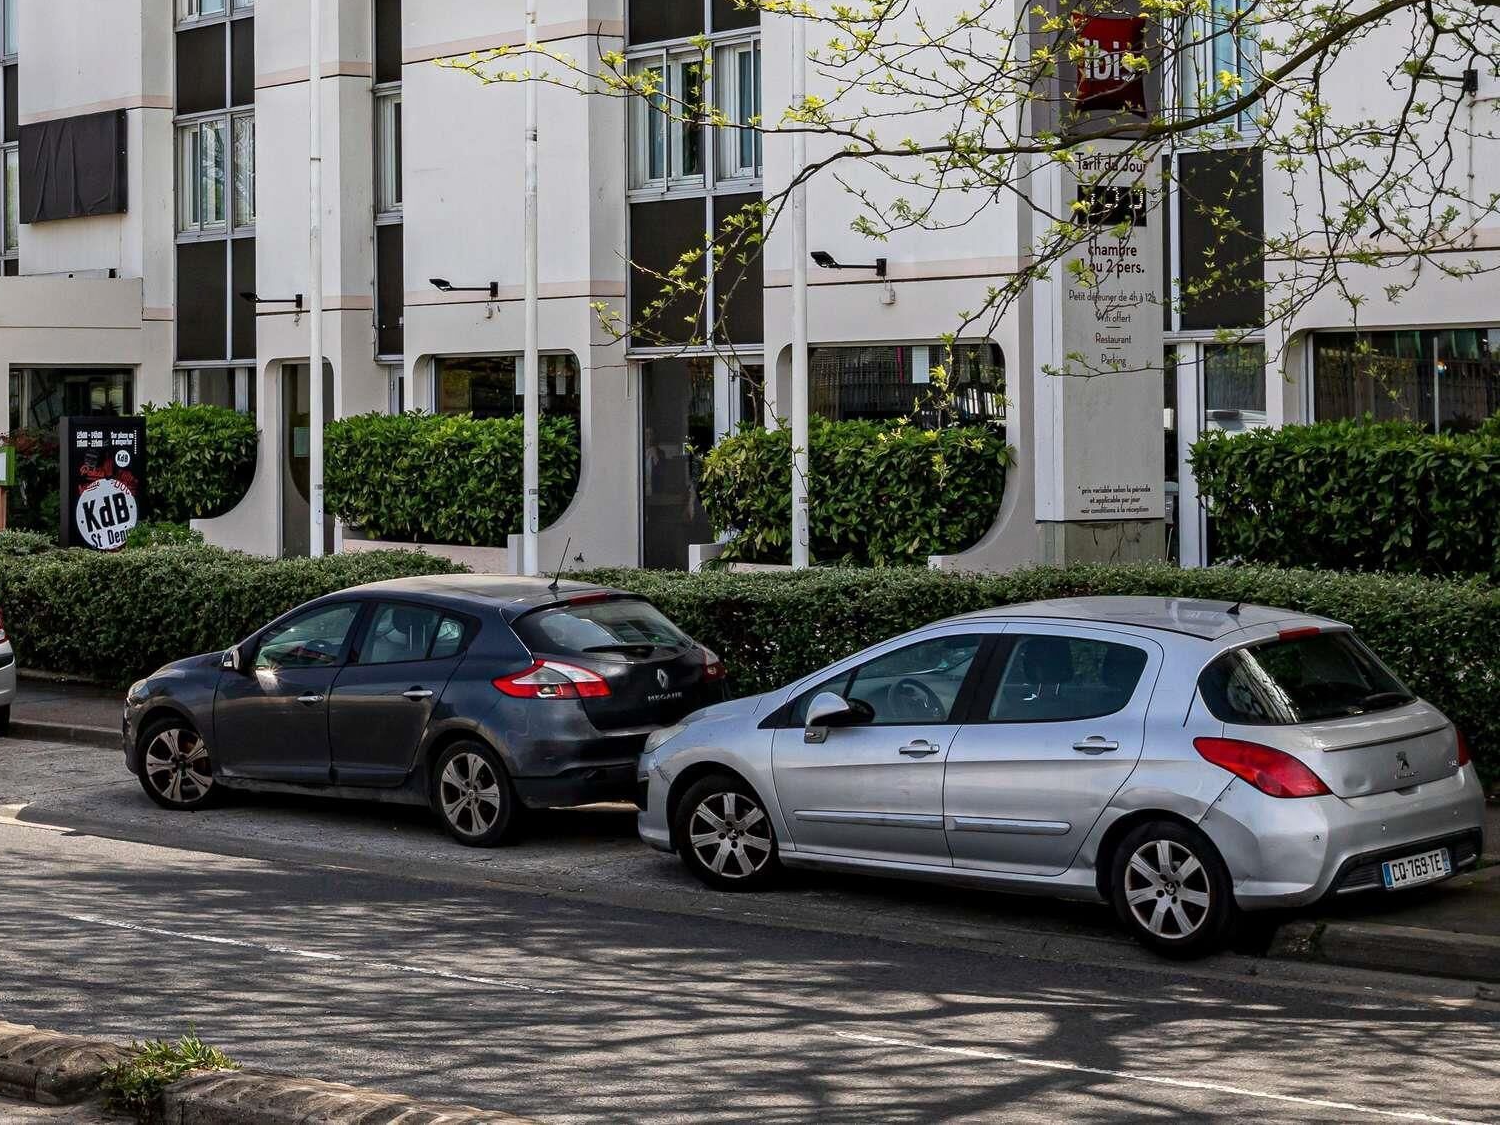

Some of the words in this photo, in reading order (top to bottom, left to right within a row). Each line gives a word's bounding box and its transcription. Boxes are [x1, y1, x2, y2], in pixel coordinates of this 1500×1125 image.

[1075, 152, 1101, 171] Tarif
[1106, 259, 1114, 273] 2
[1117, 262, 1145, 279] pers.
[1069, 289, 1086, 301] Petit
[1118, 290, 1127, 302] de
[1112, 310, 1131, 323] offert
[1095, 332, 1131, 344] Restaurant
[1101, 353, 1126, 367] Parking
[82, 492, 130, 533] KdB
[91, 533, 103, 548] St
[1392, 853, 1443, 882] CQ-769-TE
